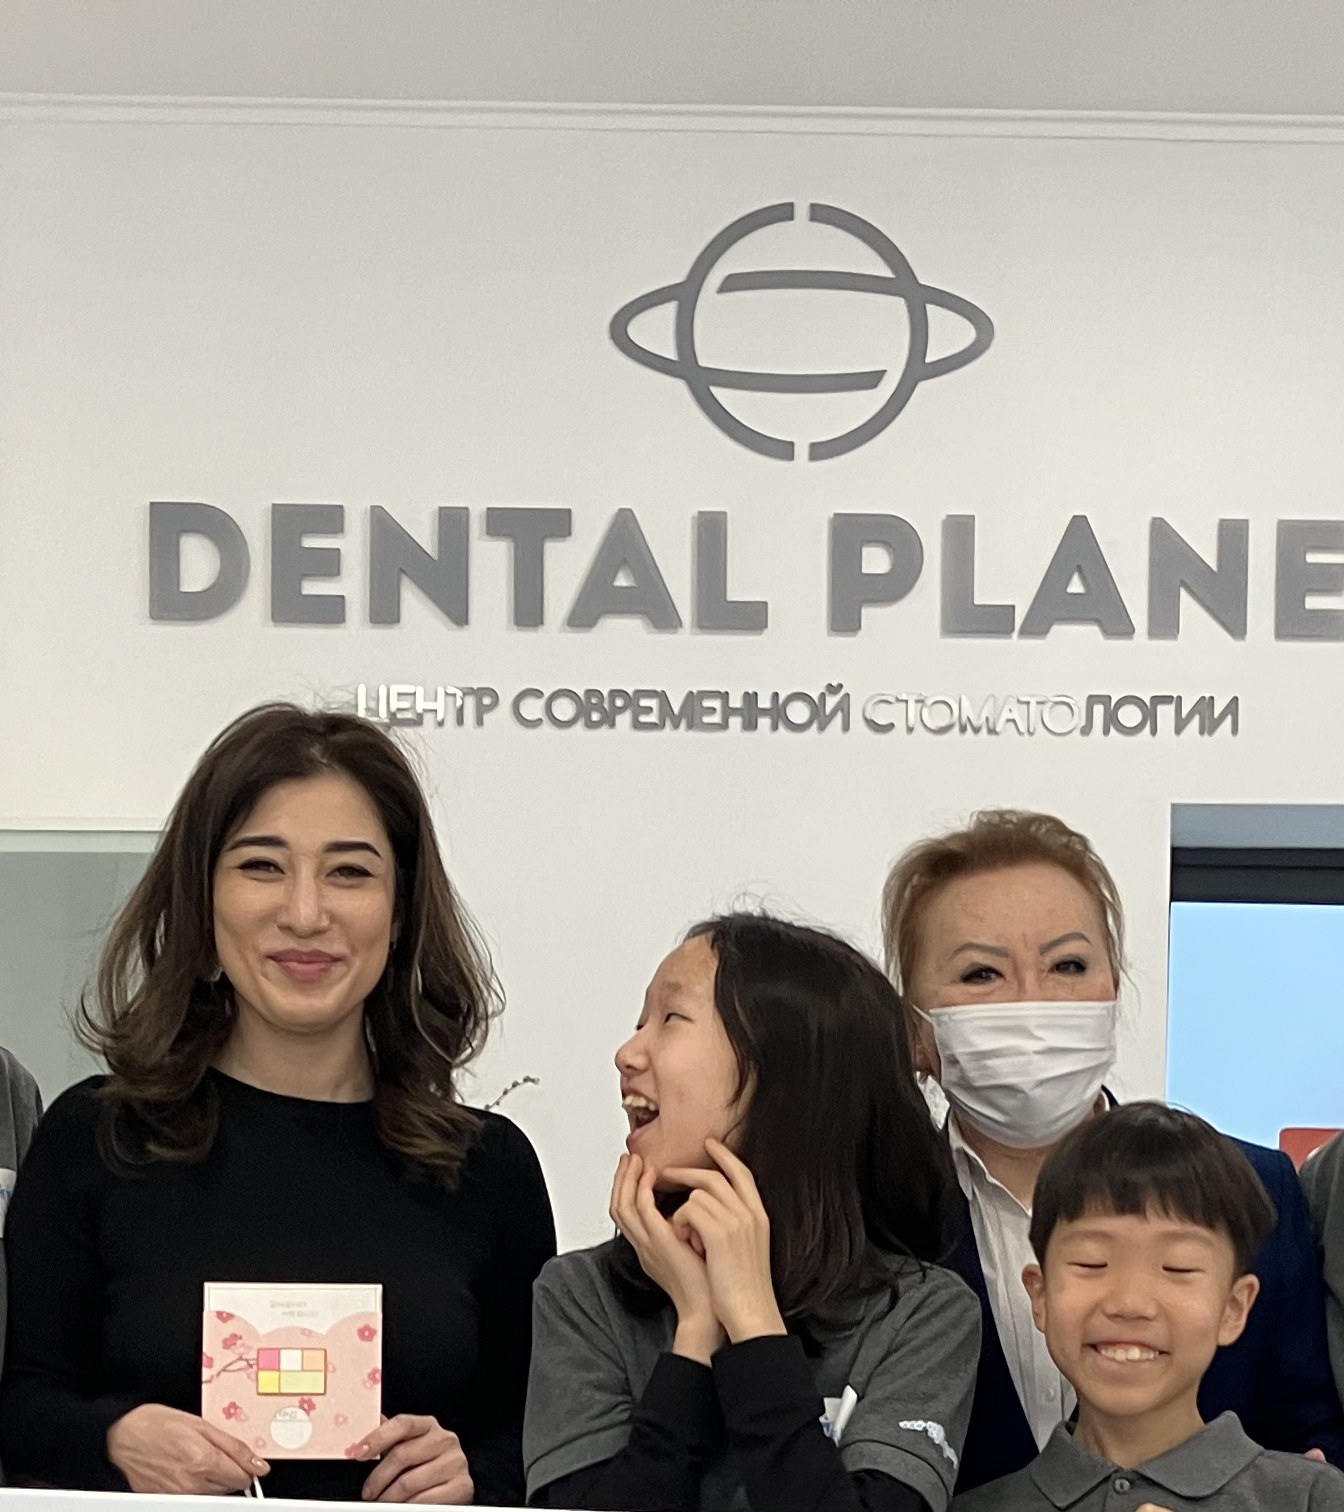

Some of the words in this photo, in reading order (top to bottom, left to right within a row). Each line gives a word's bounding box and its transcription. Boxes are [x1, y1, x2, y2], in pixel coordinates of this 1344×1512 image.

[147, 501, 770, 635] DENTAL
[357, 683, 500, 728] ЦЕНТР
[511, 682, 851, 733] СОВРЕМЕННОЙ
[861, 692, 1240, 737] СТОМАТОЛОГИИ
